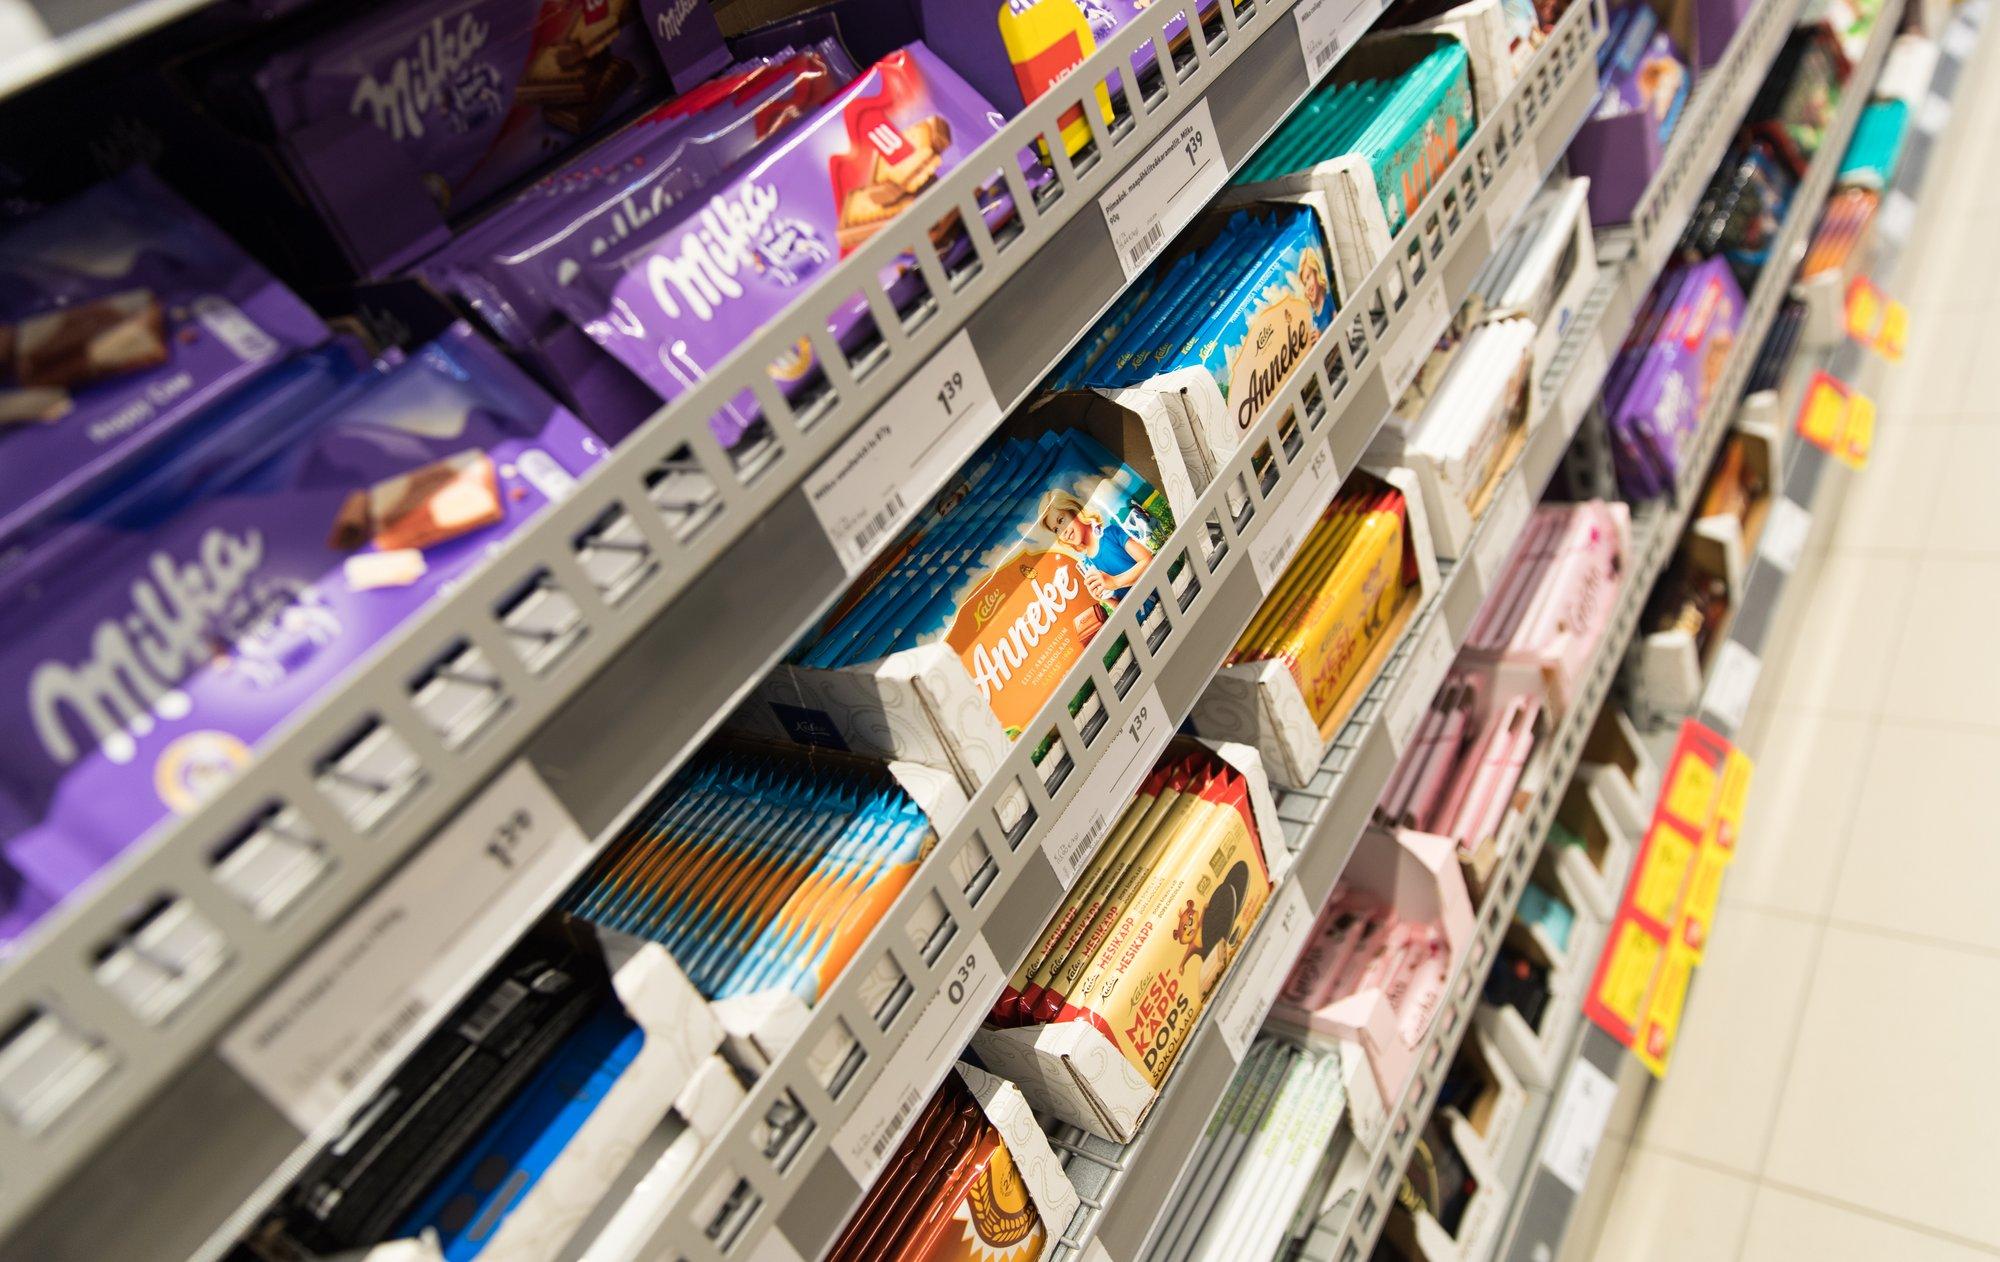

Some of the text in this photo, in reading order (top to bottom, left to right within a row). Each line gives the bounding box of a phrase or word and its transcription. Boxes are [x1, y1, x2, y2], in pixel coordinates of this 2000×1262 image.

[351, 12, 491, 139] Milka
[647, 181, 778, 322] Milka
[1238, 318, 1308, 430] Anneke
[1255, 323, 1274, 357] Kalev
[28, 527, 264, 766] Milka
[971, 564, 1080, 703] Anneke
[973, 588, 1006, 632] Kalev
[1129, 706, 1147, 744] 139
[1082, 905, 1118, 958] MESIKÄPP
[1098, 917, 1135, 970] MESIKÄPP
[1116, 920, 1154, 975] MESIKÄPP
[949, 954, 976, 1005] 039
[1125, 968, 1171, 1044] MESI-
[1134, 979, 1179, 1058] KÄPP
[1143, 992, 1189, 1072] DOPS
[1152, 1008, 1194, 1080] ŠOKOLAAD
